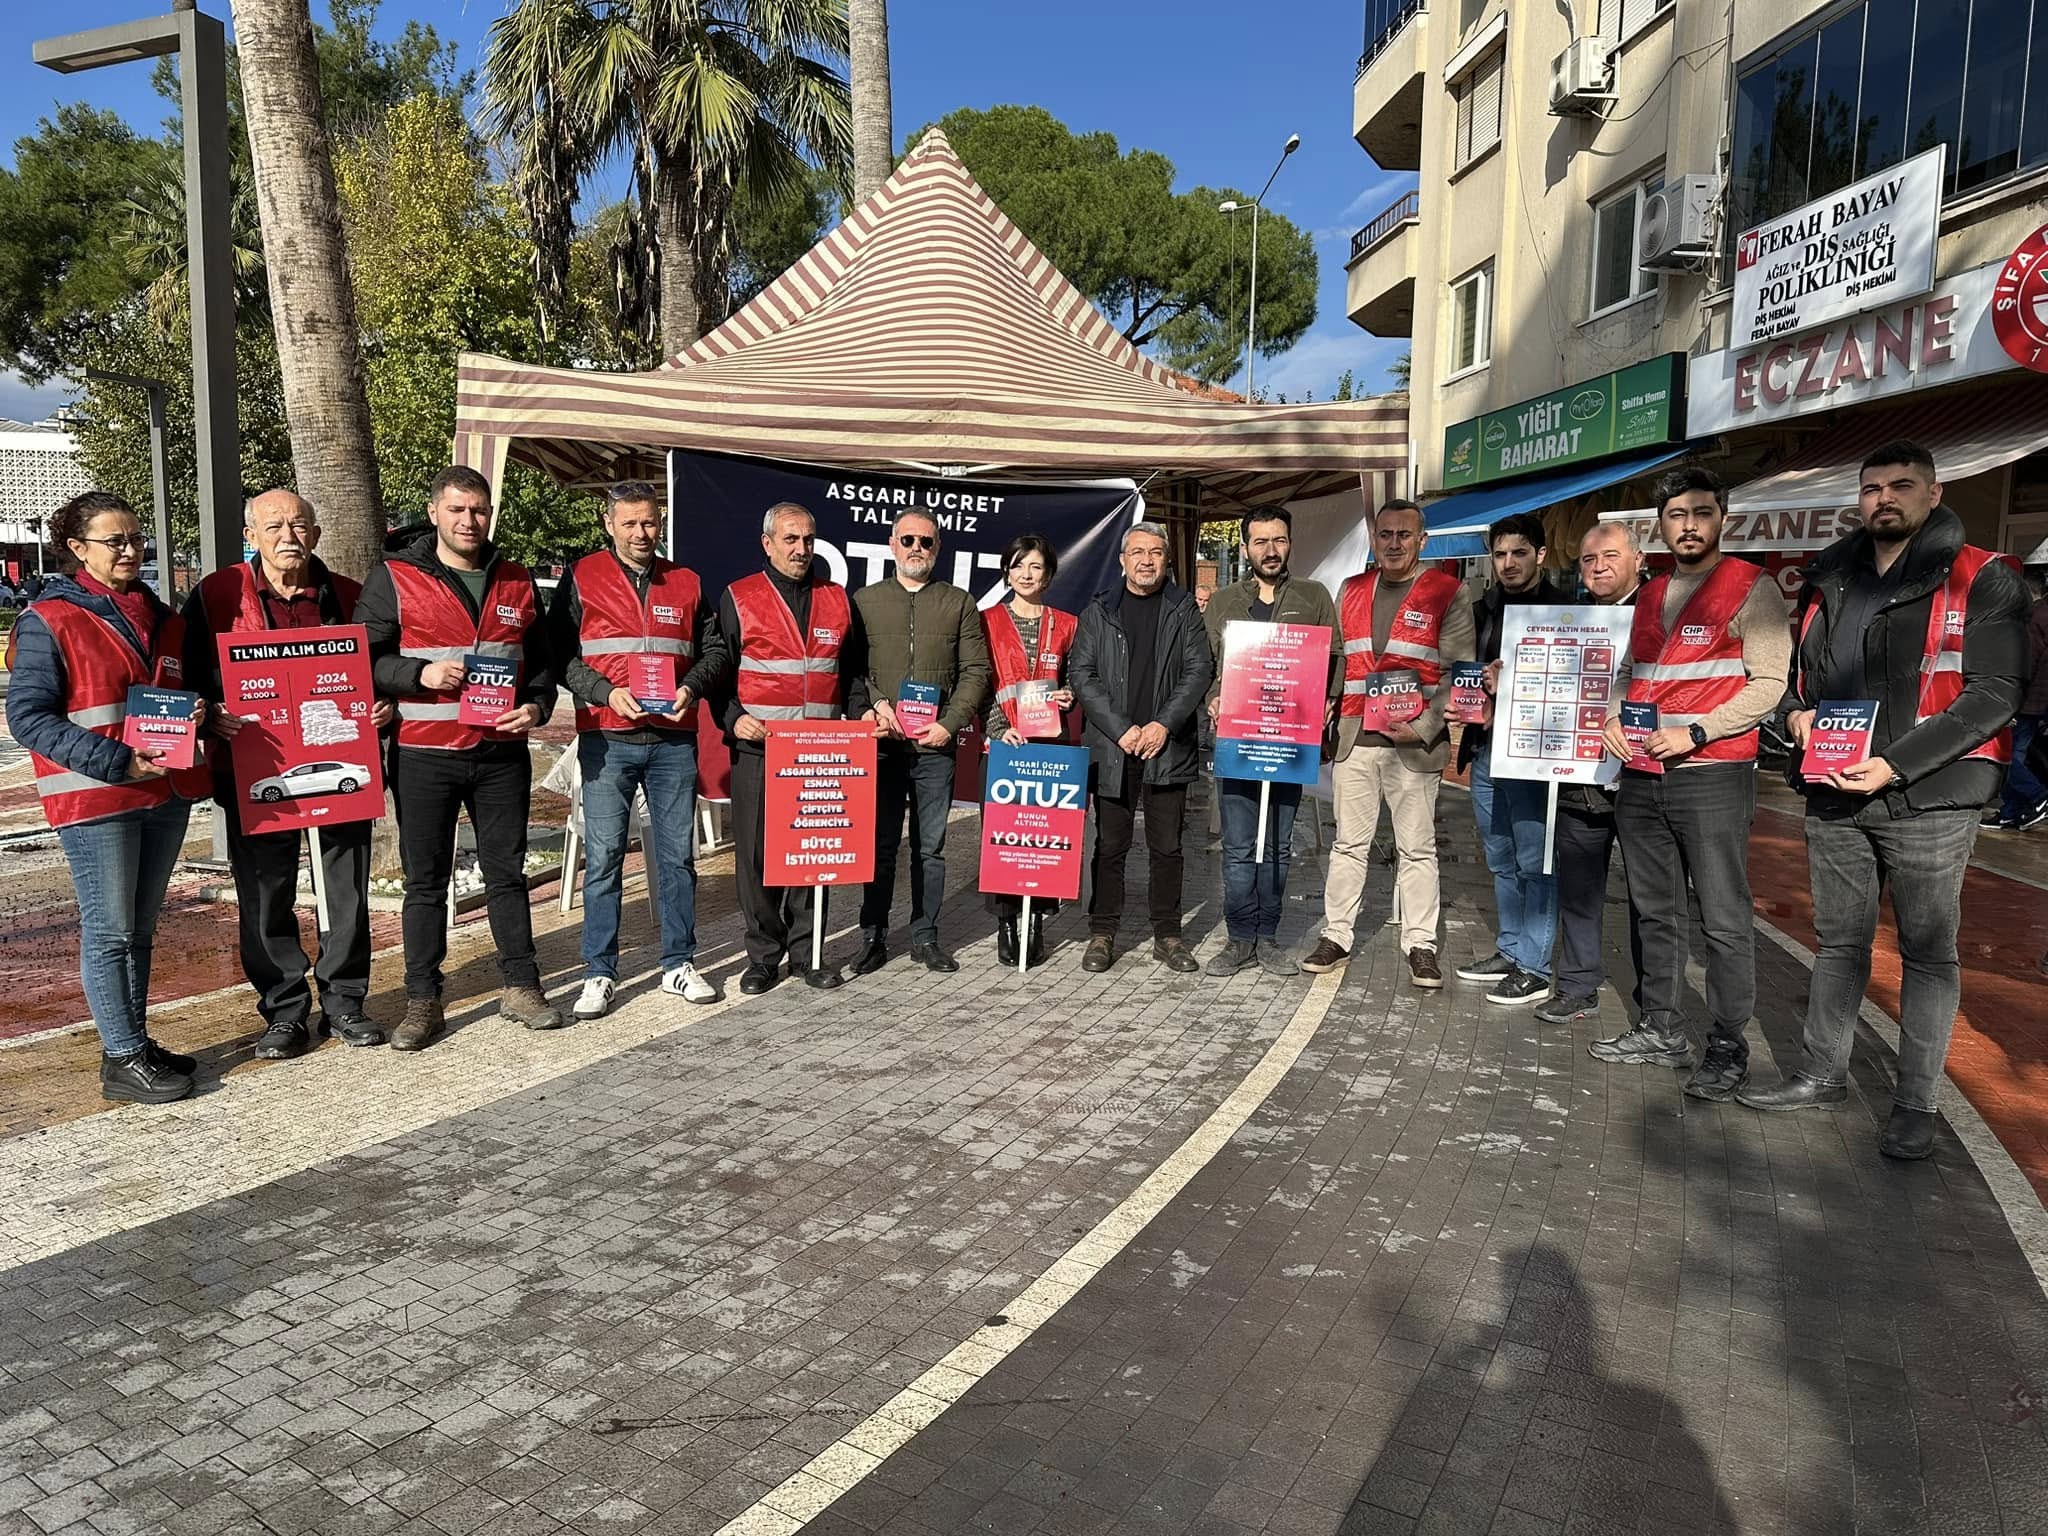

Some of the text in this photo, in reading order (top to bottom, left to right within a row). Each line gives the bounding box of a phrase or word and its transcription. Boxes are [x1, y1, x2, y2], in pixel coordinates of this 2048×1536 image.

[1758, 176, 1905, 258] FERAH BAYAV
[1765, 222, 1890, 282] AĞIZ ve DİŞ SAĞLIĞI
[1758, 235, 1896, 310] POLİKLİNİĞİ
[1846, 267, 1896, 297] DİŞ HEKİMİ
[1996, 251, 2035, 311] ŞİFA
[1755, 302, 1796, 326] DİŞ HEKİMİ
[1751, 316, 1800, 341] FERAH BAYAV
[1733, 294, 1959, 416] ECZANE
[1517, 400, 1563, 438] YİĞİT
[1500, 427, 1582, 470] BAHARAT
[826, 482, 1005, 514] ASGARİ ÜCRET
[850, 506, 978, 532] TALMİZ
[498, 606, 514, 617] CHP
[655, 607, 672, 615] CHP
[1406, 611, 1421, 620] CHP
[1683, 626, 1703, 636] CHP
[232, 639, 355, 660] TL'NİN ALIM GÜCÜ
[1554, 657, 1566, 665] 7,5
[1591, 652, 1597, 660] 7
[240, 677, 275, 691] 2009
[316, 672, 348, 685] 2024
[468, 672, 514, 687] OTUZ
[1454, 677, 1483, 688] OTU
[1381, 682, 1418, 696] OTUZ
[1583, 681, 1598, 689] 5,5
[242, 691, 269, 700] 26.000
[468, 696, 508, 706] YOKUZ!
[1455, 697, 1486, 705] YOKUZ!
[159, 705, 169, 714] 1
[350, 701, 367, 713] 90
[1385, 701, 1417, 710] YOKUZ!
[271, 708, 288, 720] 1.3
[1584, 711, 1591, 719] 4
[1634, 716, 1640, 725] 1
[1818, 717, 1868, 731] OTUZ
[139, 722, 187, 734] ŞARTTIR
[1579, 739, 1594, 747] 1,25
[1814, 742, 1857, 751] YOKUZ!
[797, 752, 847, 763] EMEKLİYE
[1008, 760, 1070, 771] ASGARİ ÜCRET
[1552, 767, 1574, 775] CHP
[779, 767, 864, 776] ASGARİ ÜCRETLİYE
[1016, 768, 1061, 778] TALEBİMİZ
[804, 779, 840, 788] ESNAFA
[799, 791, 844, 800] MEMURA
[990, 778, 1080, 810] OTUZ
[801, 804, 842, 815] ÇİFTÇİYE
[1017, 812, 1047, 821] BUNUN
[794, 817, 849, 828] ÖĞRENCİYE
[1014, 820, 1049, 828] ALTINDA
[801, 836, 841, 850] BÜTÇE
[992, 831, 1069, 850] YOKUZ!
[785, 852, 856, 866] İSTİYORUZ!
[817, 872, 837, 882] CHP
